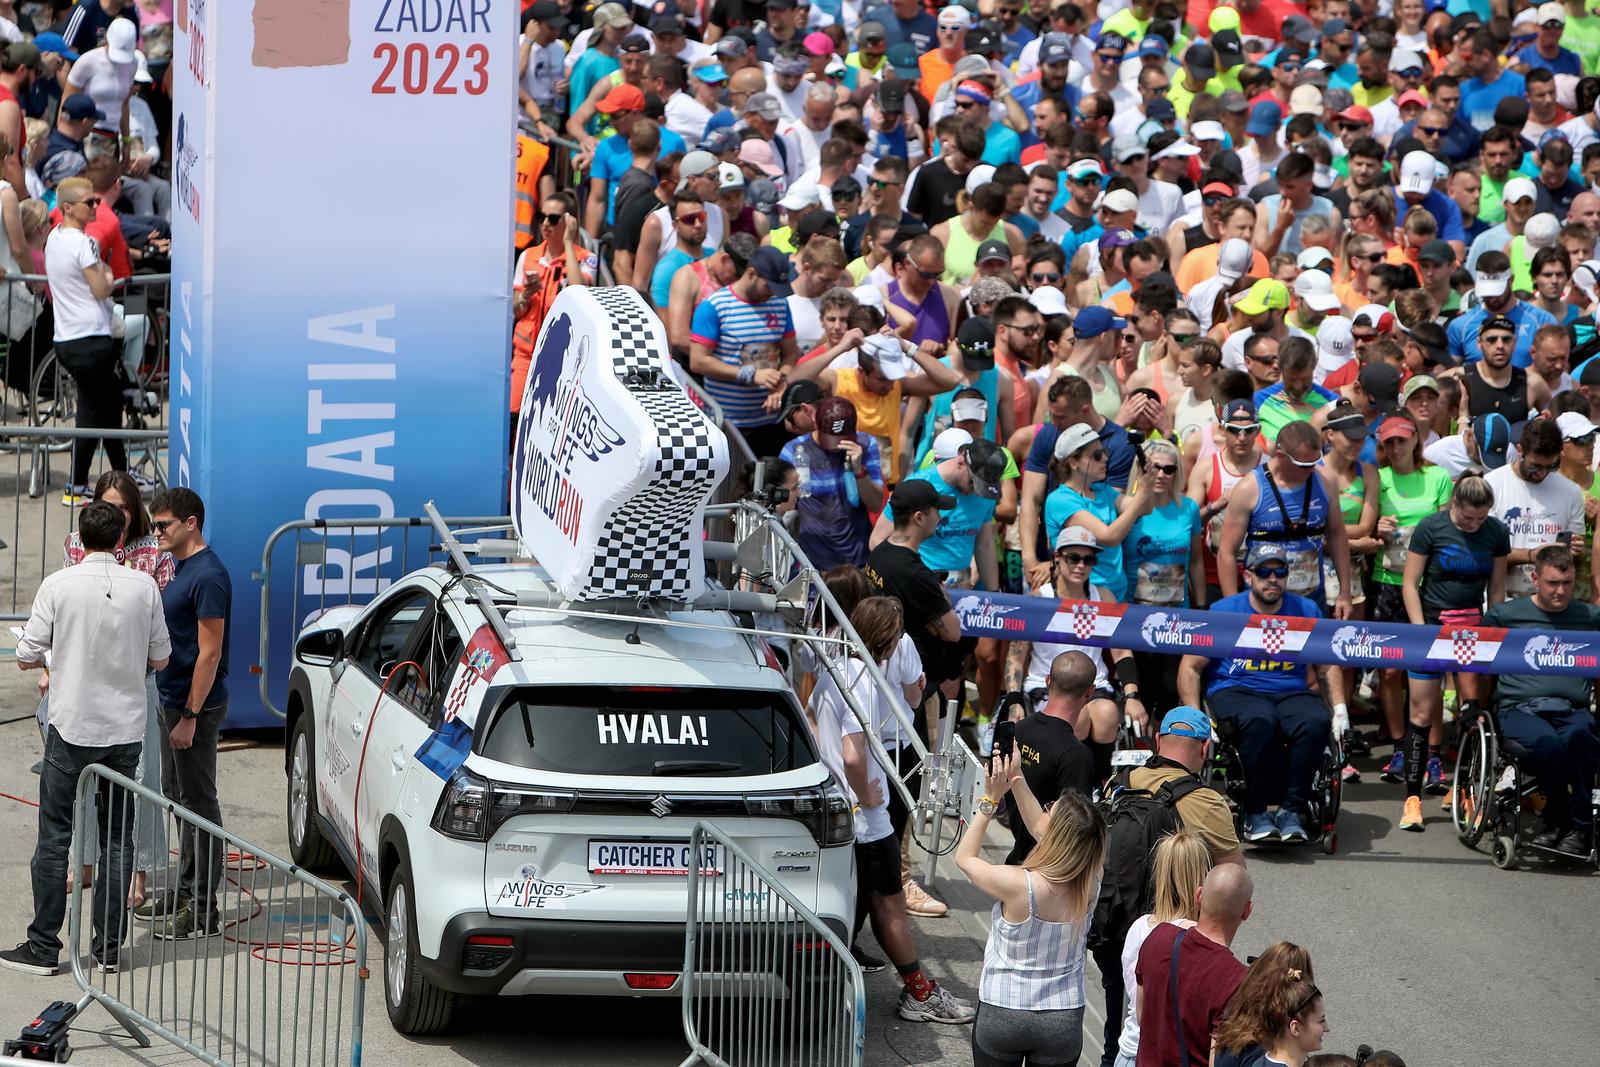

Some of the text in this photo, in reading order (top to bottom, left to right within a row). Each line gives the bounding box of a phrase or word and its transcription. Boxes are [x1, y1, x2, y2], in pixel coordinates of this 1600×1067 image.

[374, 0, 491, 33] ZADAR
[371, 42, 490, 96] 2023
[555, 379, 598, 450] WINGS
[303, 303, 397, 626] ROATIA
[550, 426, 579, 475] LIFE
[597, 714, 709, 746] HVALA!
[598, 845, 675, 868] CATCHER
[507, 881, 565, 896] WINGS
[514, 894, 547, 908] LIFE
